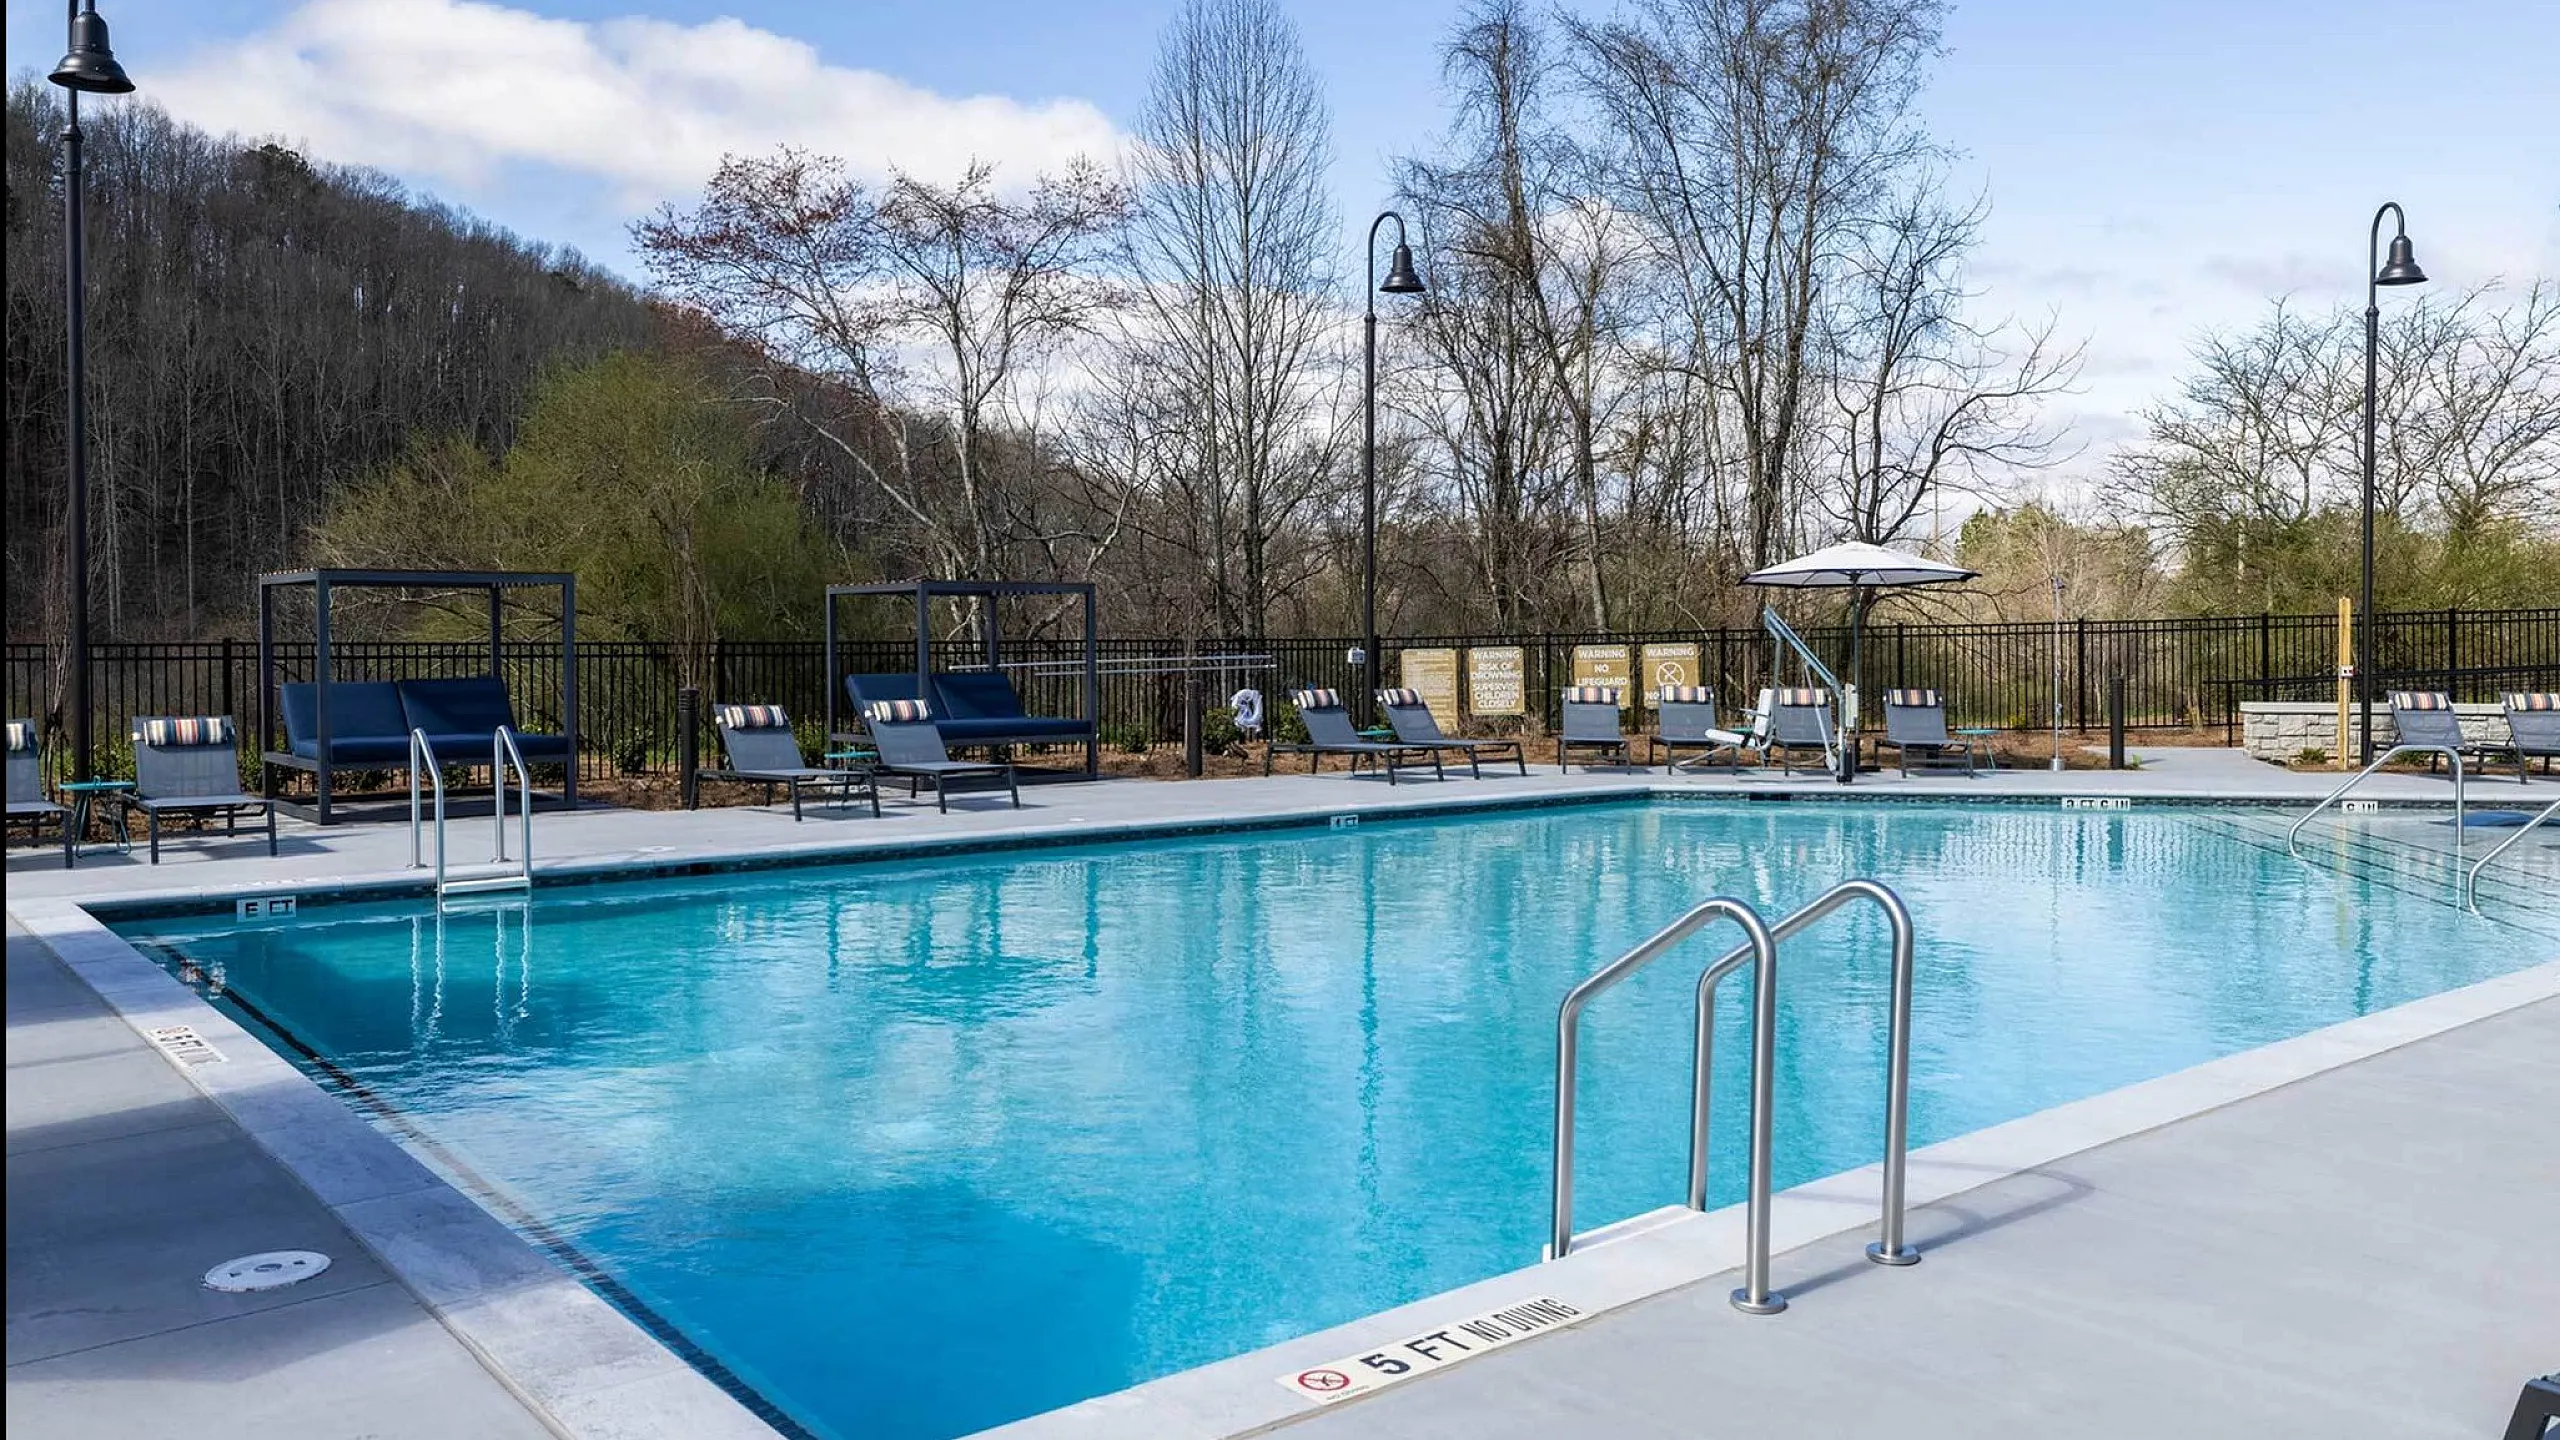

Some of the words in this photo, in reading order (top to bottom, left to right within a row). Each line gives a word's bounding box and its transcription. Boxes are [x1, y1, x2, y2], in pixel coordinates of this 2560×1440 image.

[1472, 650, 1520, 660] WARNING
[1578, 648, 1626, 659] WARNING
[1647, 647, 1695, 657] WARNING
[1478, 662, 1500, 671] RISK
[1501, 662, 1515, 671] OF
[1594, 663, 1610, 674] NO
[1471, 671, 1520, 680] DROWNING
[1576, 675, 1628, 686] LIFEGUARD
[1475, 691, 1520, 700] CHILDREN
[1478, 700, 1516, 709] CLOSELY
[1359, 1353, 1411, 1375] 5
[1403, 1330, 1472, 1362] FT
[1457, 1319, 1513, 1344] NO
[1491, 1298, 1580, 1332] DIVING
